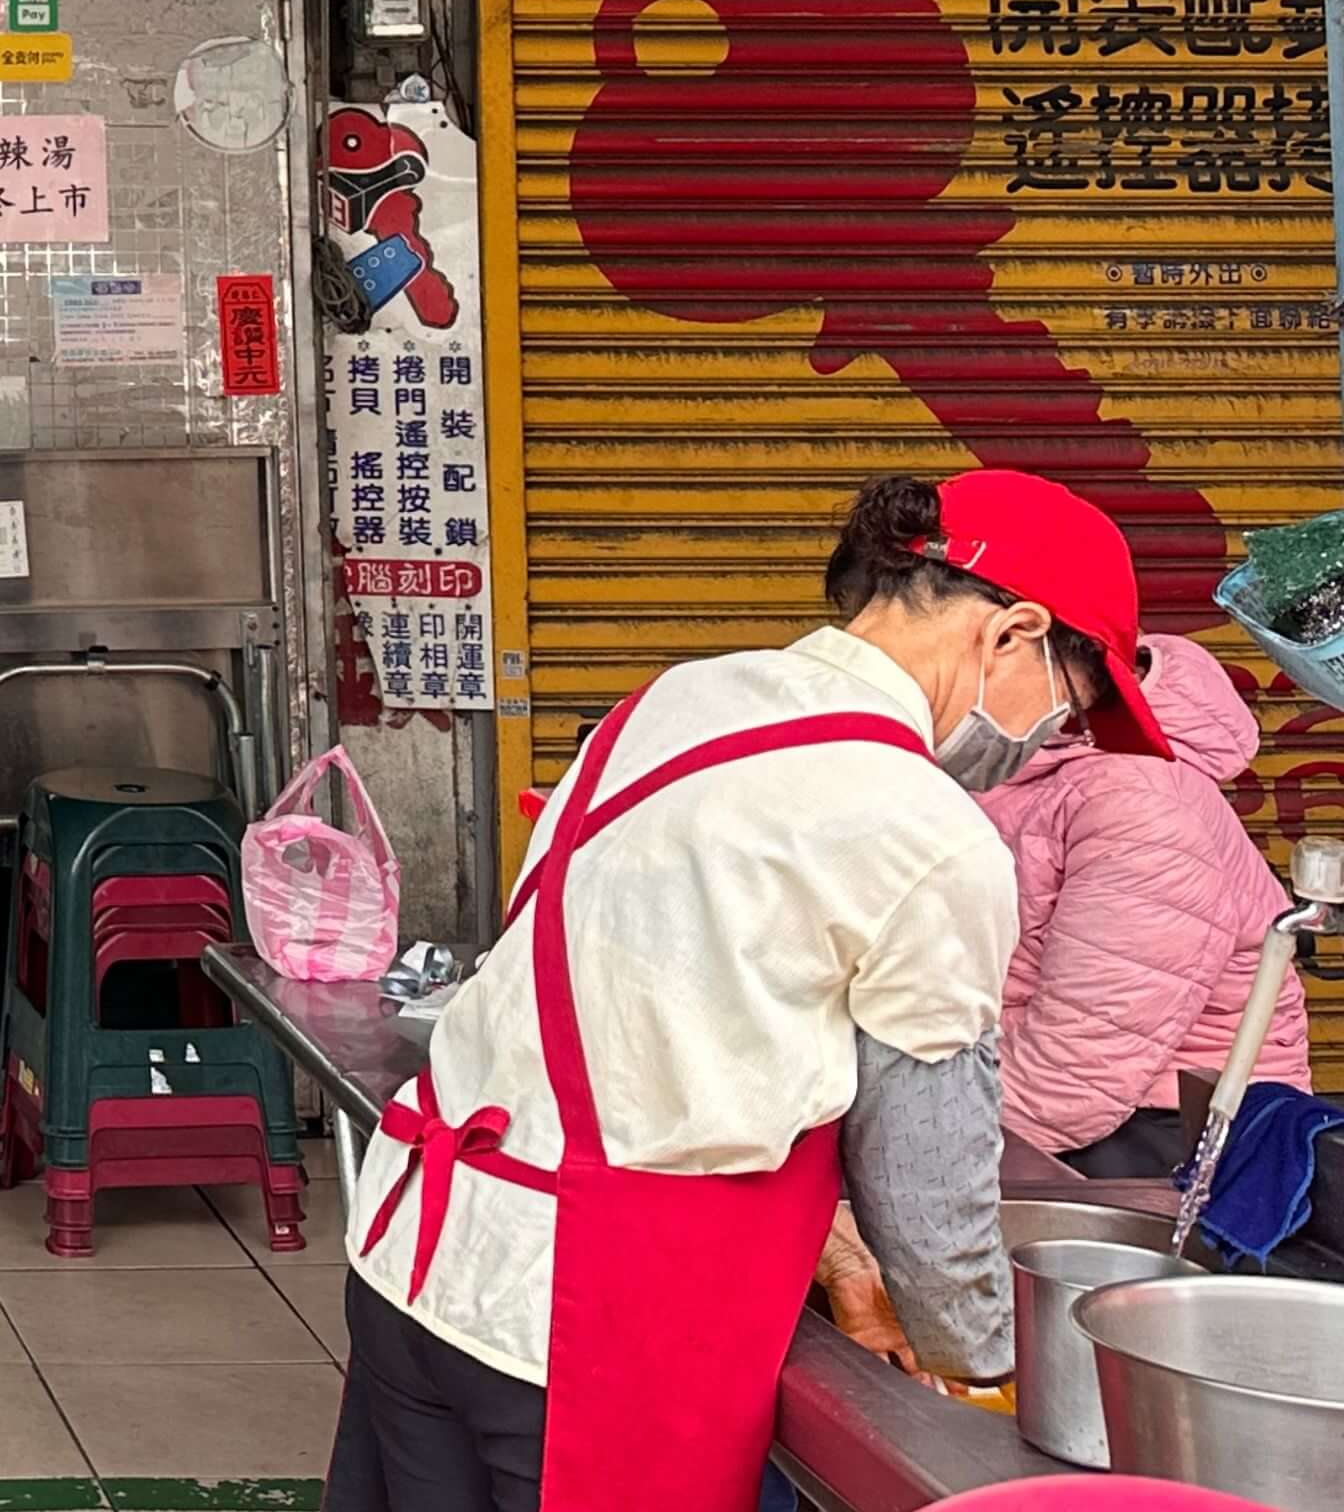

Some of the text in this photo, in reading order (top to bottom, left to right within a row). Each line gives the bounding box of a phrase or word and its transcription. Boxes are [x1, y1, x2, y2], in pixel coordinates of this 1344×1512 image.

[2, 50, 40, 65] 全支付
[22, 8, 46, 21] Pay
[439, 356, 479, 548] 開裝配鎖
[382, 611, 413, 699] 連續章
[419, 613, 450, 699] 印相章
[455, 613, 487, 700] 開運章
